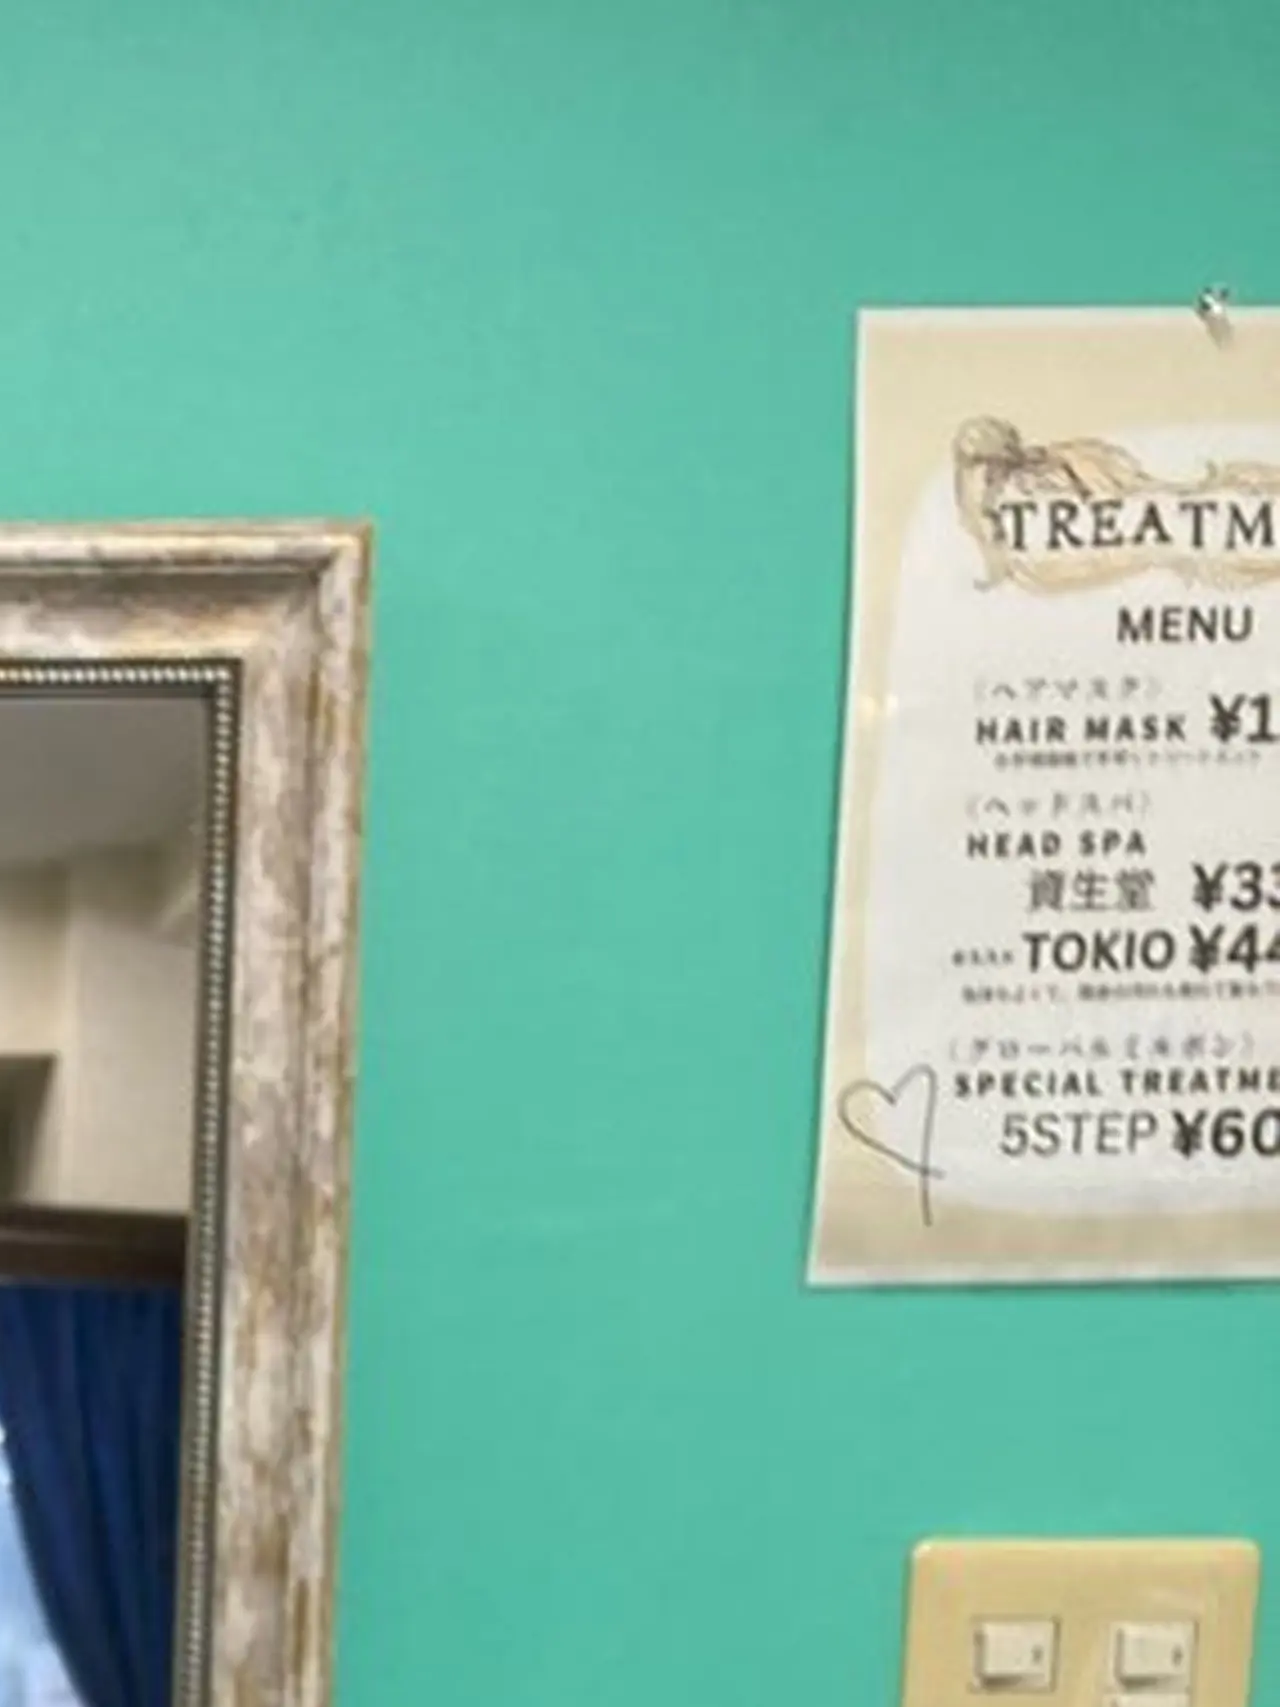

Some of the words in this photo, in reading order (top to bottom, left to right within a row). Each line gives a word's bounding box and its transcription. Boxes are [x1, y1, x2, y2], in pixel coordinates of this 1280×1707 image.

[1116, 605, 1254, 645] MENU
[975, 714, 1067, 745] HAIR
[1083, 713, 1187, 743] MASK
[966, 830, 1062, 859] HEAD
[1078, 829, 1147, 857] SPA
[1026, 867, 1156, 913] 資生堂
[1021, 930, 1176, 973] TOKIO
[955, 1070, 1100, 1098] SPECIAL
[1000, 1112, 1159, 1157] 5STEP
